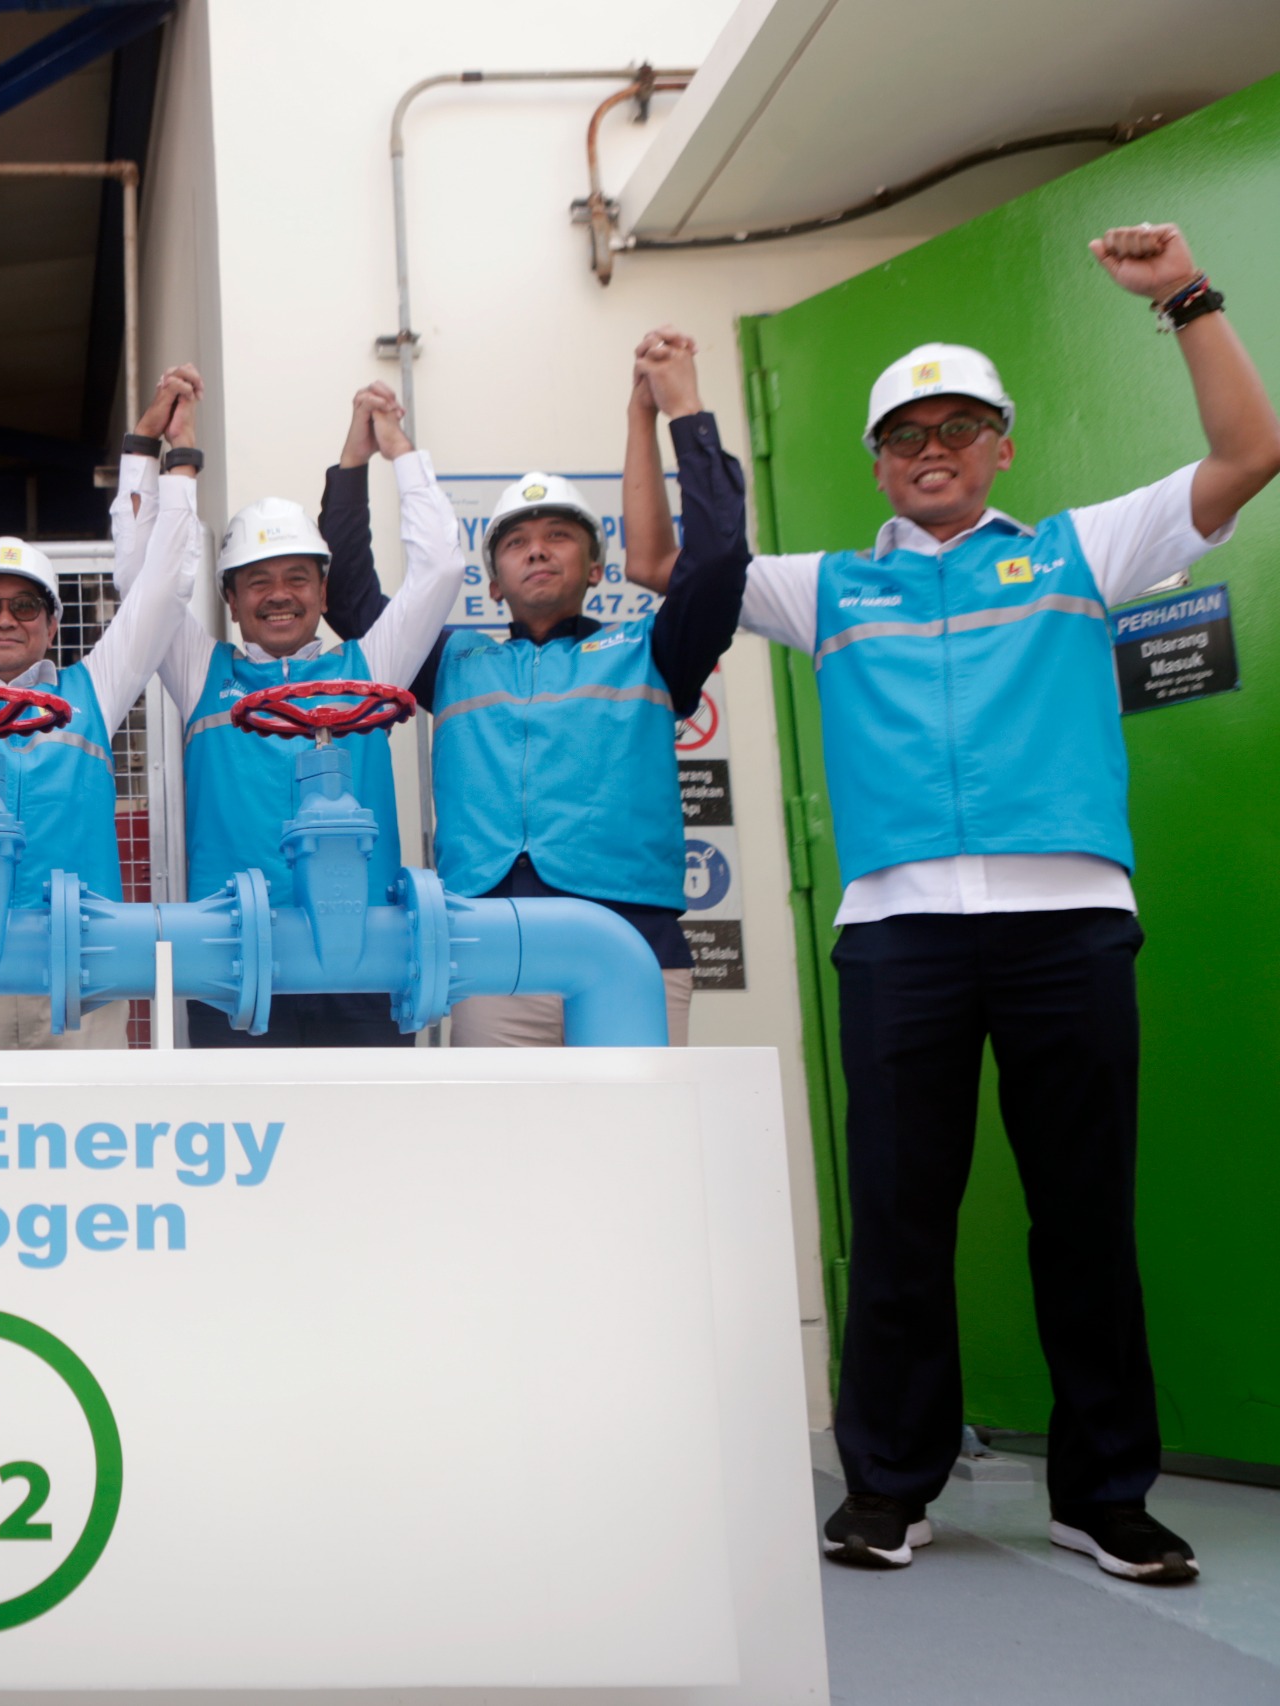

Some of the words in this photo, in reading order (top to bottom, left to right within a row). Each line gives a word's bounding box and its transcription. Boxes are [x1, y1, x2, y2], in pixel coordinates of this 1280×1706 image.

[1033, 558, 1065, 574] PLN
[586, 593, 665, 615] 47.2
[1117, 592, 1222, 636] PERHATIAN
[1140, 631, 1208, 658] Dilarang
[1150, 651, 1204, 677] Masuk
[678, 771, 712, 784] arang
